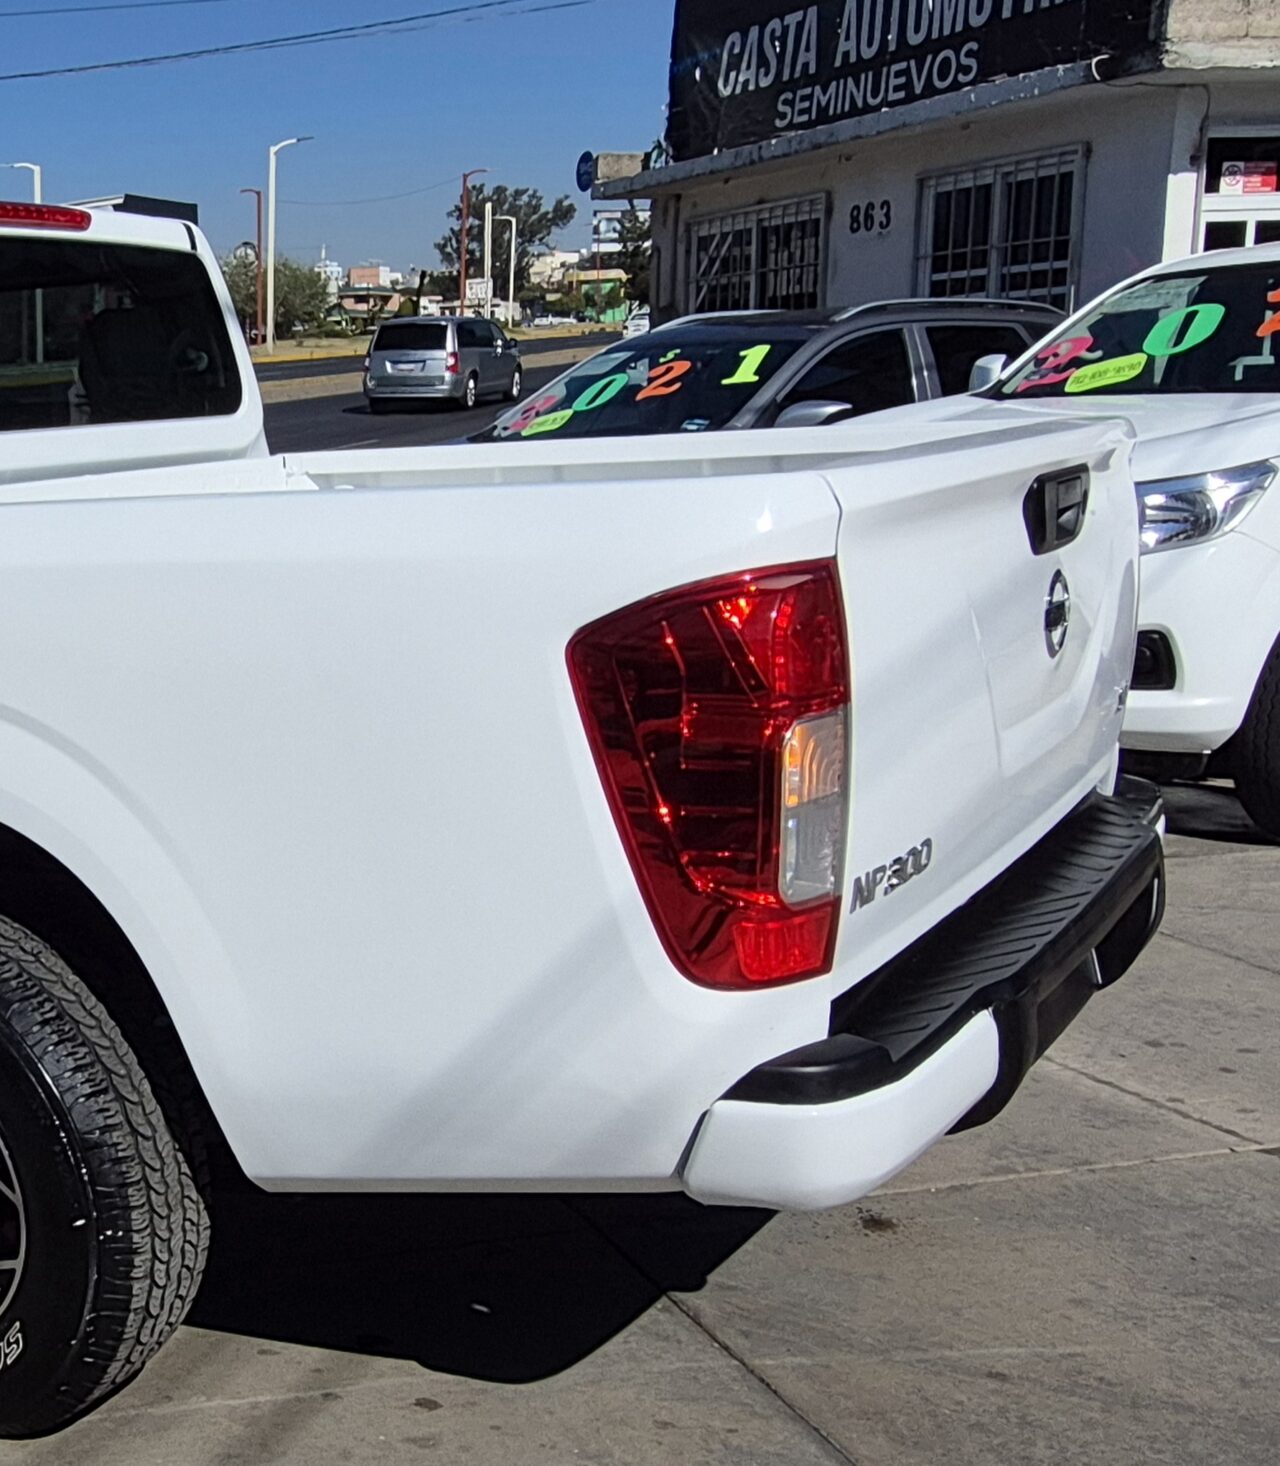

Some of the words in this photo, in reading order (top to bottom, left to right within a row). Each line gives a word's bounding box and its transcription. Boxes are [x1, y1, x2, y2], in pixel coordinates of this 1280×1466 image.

[717, 4, 818, 97] CASTA
[834, 0, 1064, 68] AUTOM
[775, 42, 980, 128] SEMINUEVOS
[849, 199, 892, 234] 863
[849, 837, 933, 914] NP300
